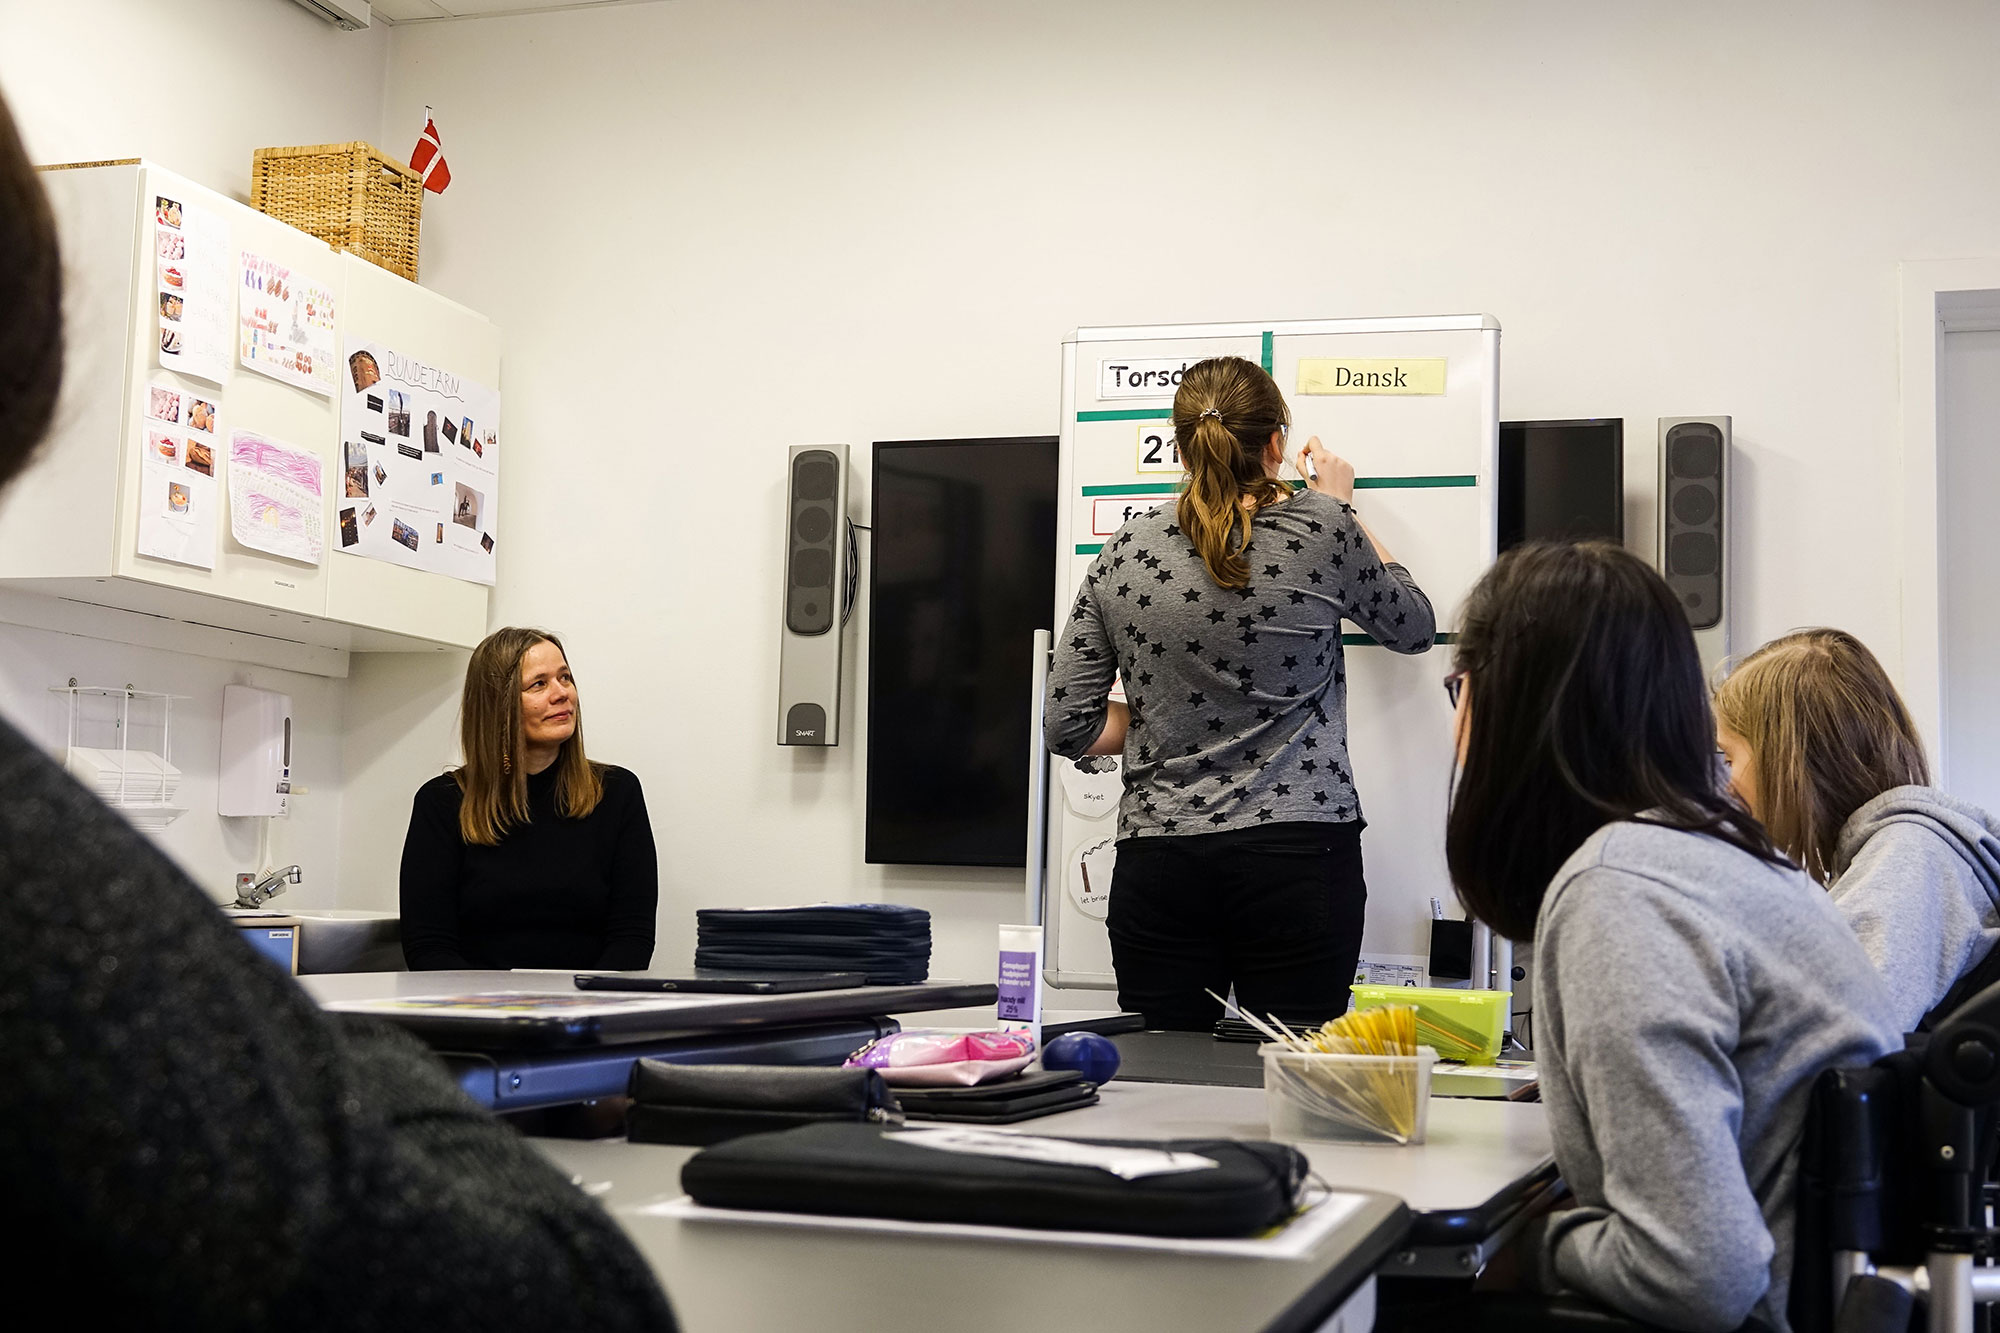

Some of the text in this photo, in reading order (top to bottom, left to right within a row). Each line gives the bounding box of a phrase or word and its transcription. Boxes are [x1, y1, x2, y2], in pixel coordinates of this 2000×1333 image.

[1109, 363, 1187, 387] Torsd
[1335, 367, 1408, 387] Dansk
[1143, 435, 1179, 463] 21
[1084, 792, 1104, 802] skyet
